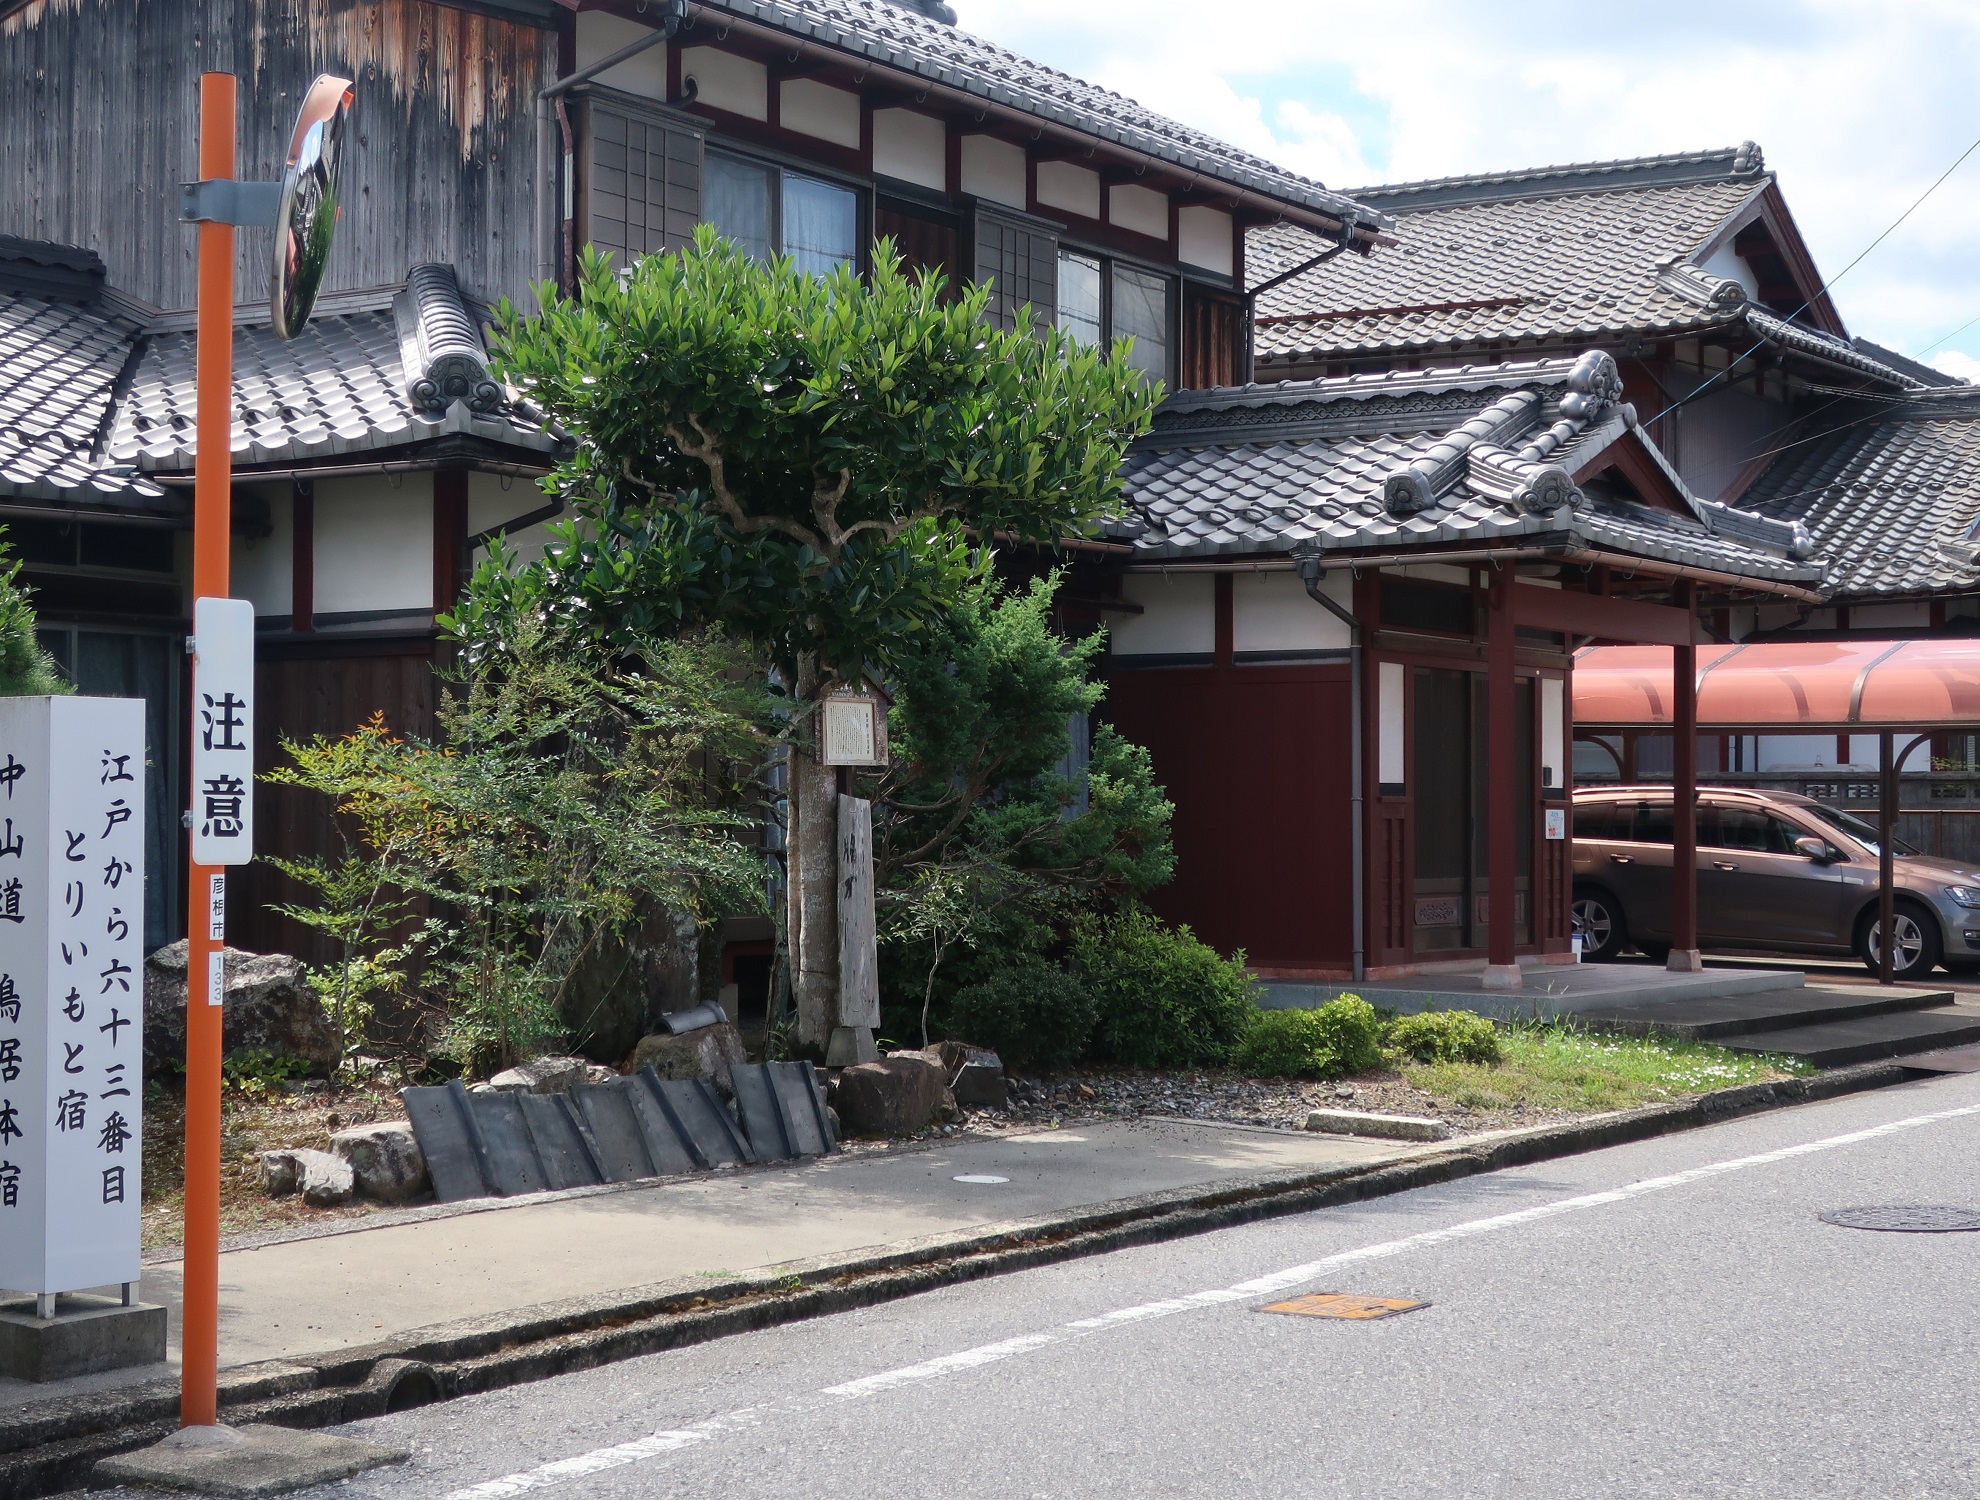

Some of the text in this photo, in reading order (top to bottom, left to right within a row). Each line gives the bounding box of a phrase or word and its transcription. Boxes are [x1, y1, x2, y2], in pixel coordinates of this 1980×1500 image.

[201, 692, 247, 838] 注意
[97, 749, 134, 1205] 江戸から六十三番目
[212, 877, 224, 938] 彦根市
[213, 956, 222, 1001] 133
[54, 829, 89, 1133] とりいもと宿
